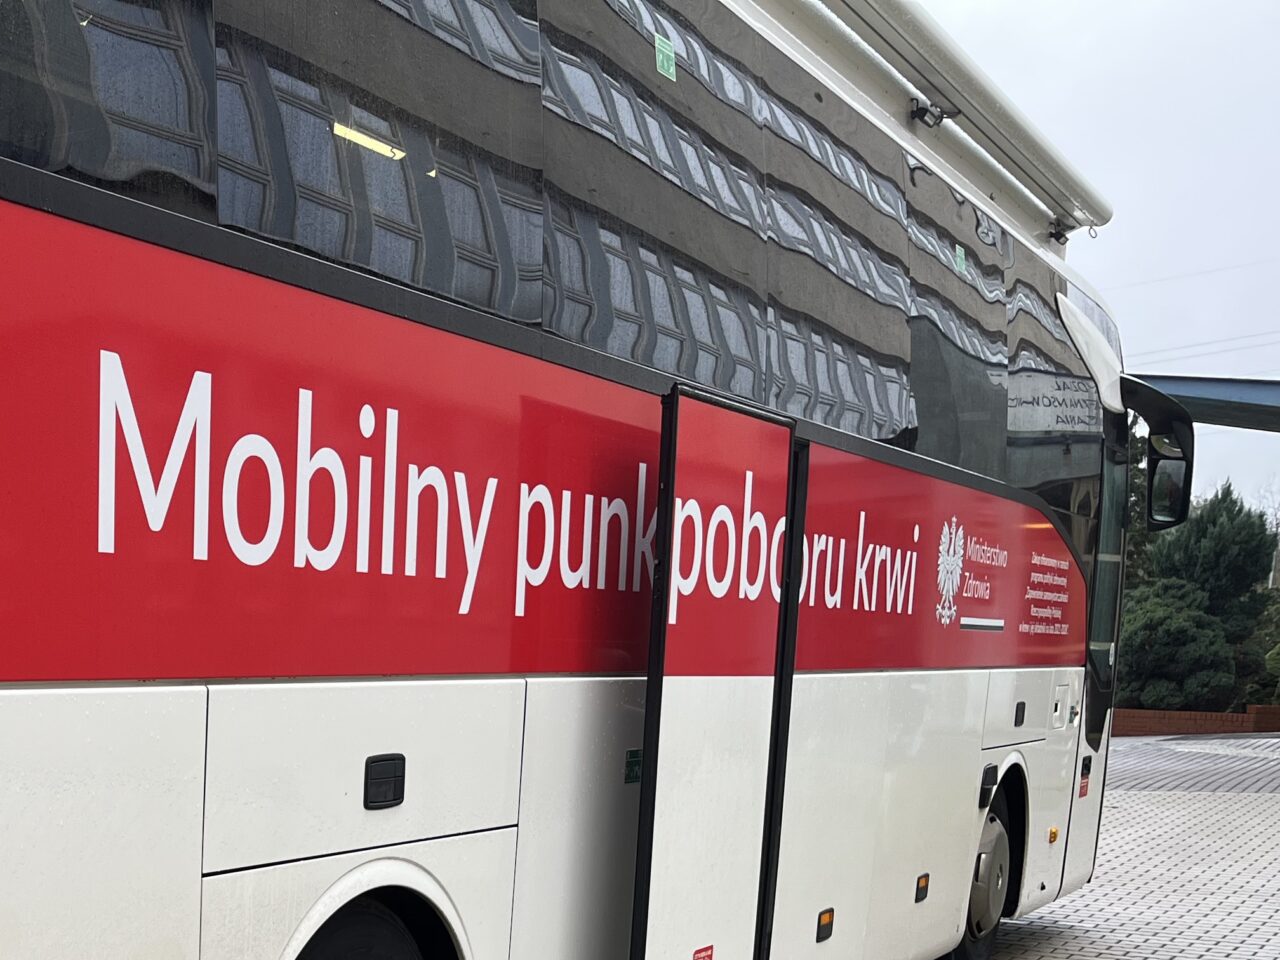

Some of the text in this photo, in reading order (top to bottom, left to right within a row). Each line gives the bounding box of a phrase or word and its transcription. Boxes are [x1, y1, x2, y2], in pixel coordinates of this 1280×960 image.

[97, 349, 499, 615] Mobilny
[514, 462, 658, 617] punk
[852, 510, 920, 615] krwi
[966, 536, 1008, 568] Ministerstwo
[962, 572, 991, 600] Zdrowia
